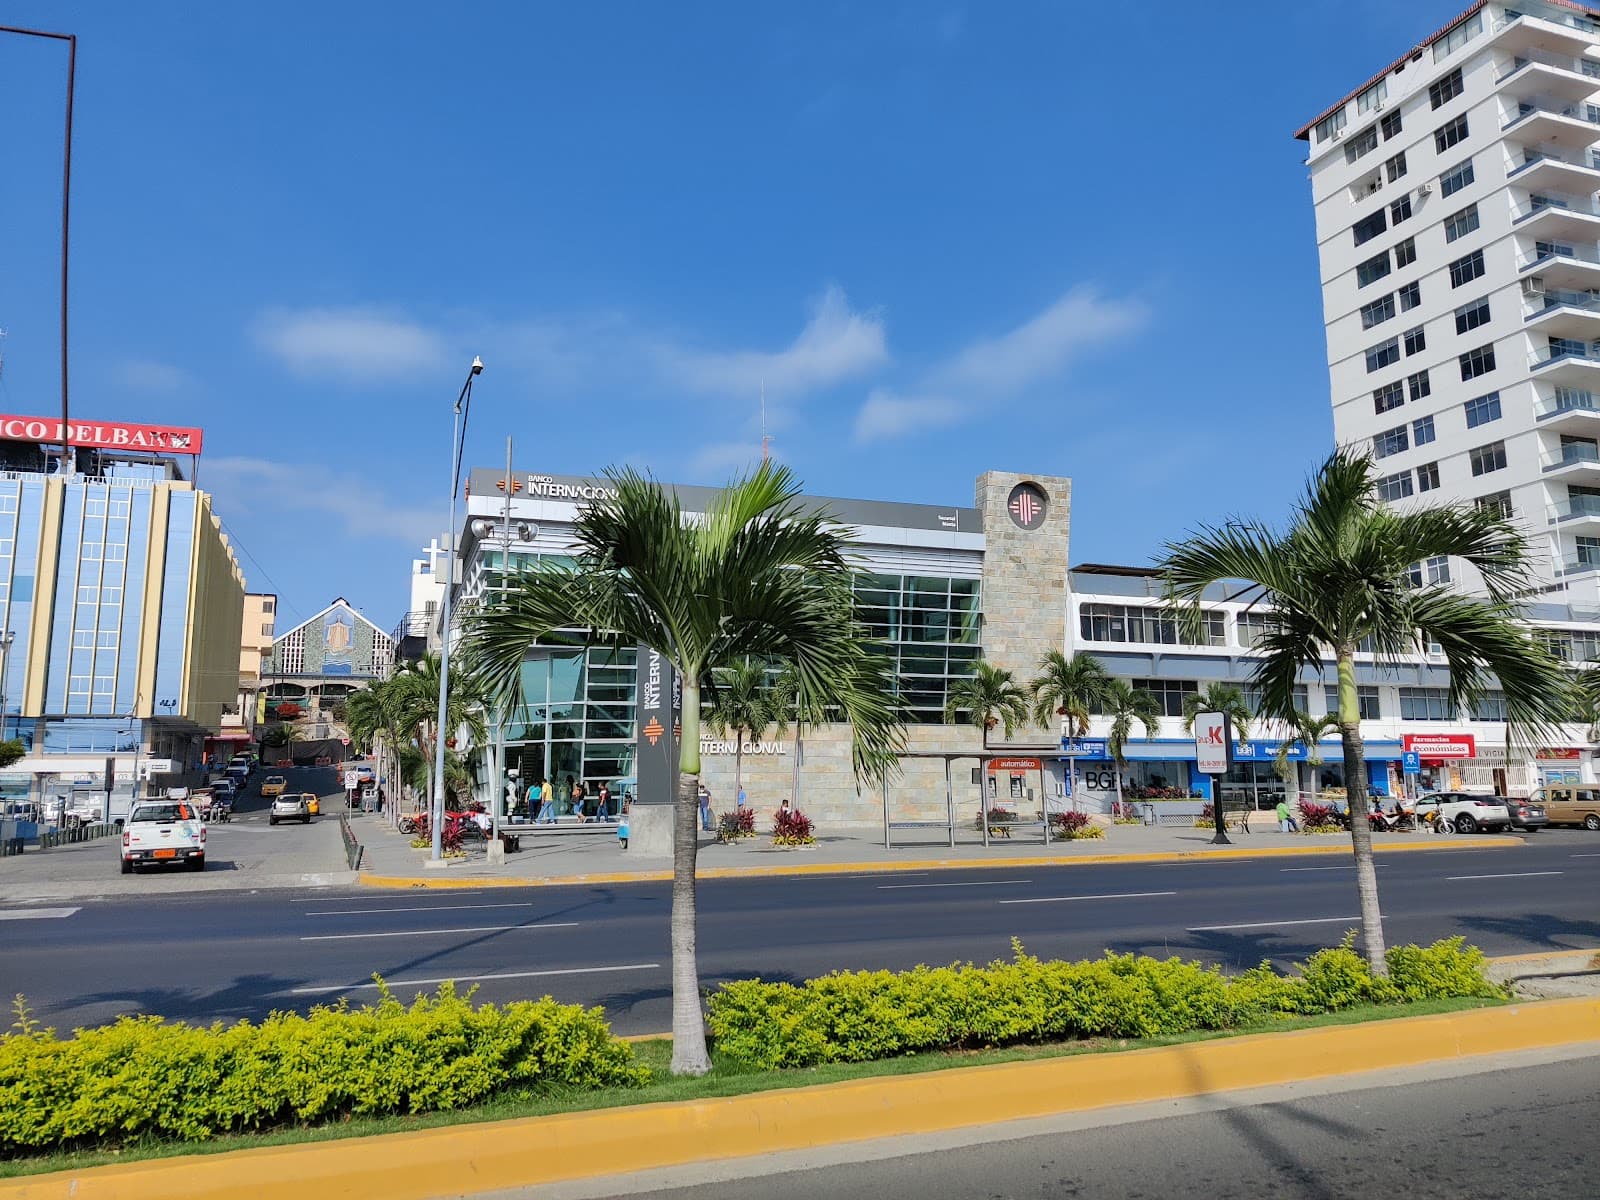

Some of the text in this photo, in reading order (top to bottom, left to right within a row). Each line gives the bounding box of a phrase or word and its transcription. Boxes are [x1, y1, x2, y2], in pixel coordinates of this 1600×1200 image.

[528, 475, 553, 484] BANCO
[528, 482, 620, 501] INTERNACION
[1413, 744, 1466, 752] económicas
[1000, 759, 1036, 768] automático
